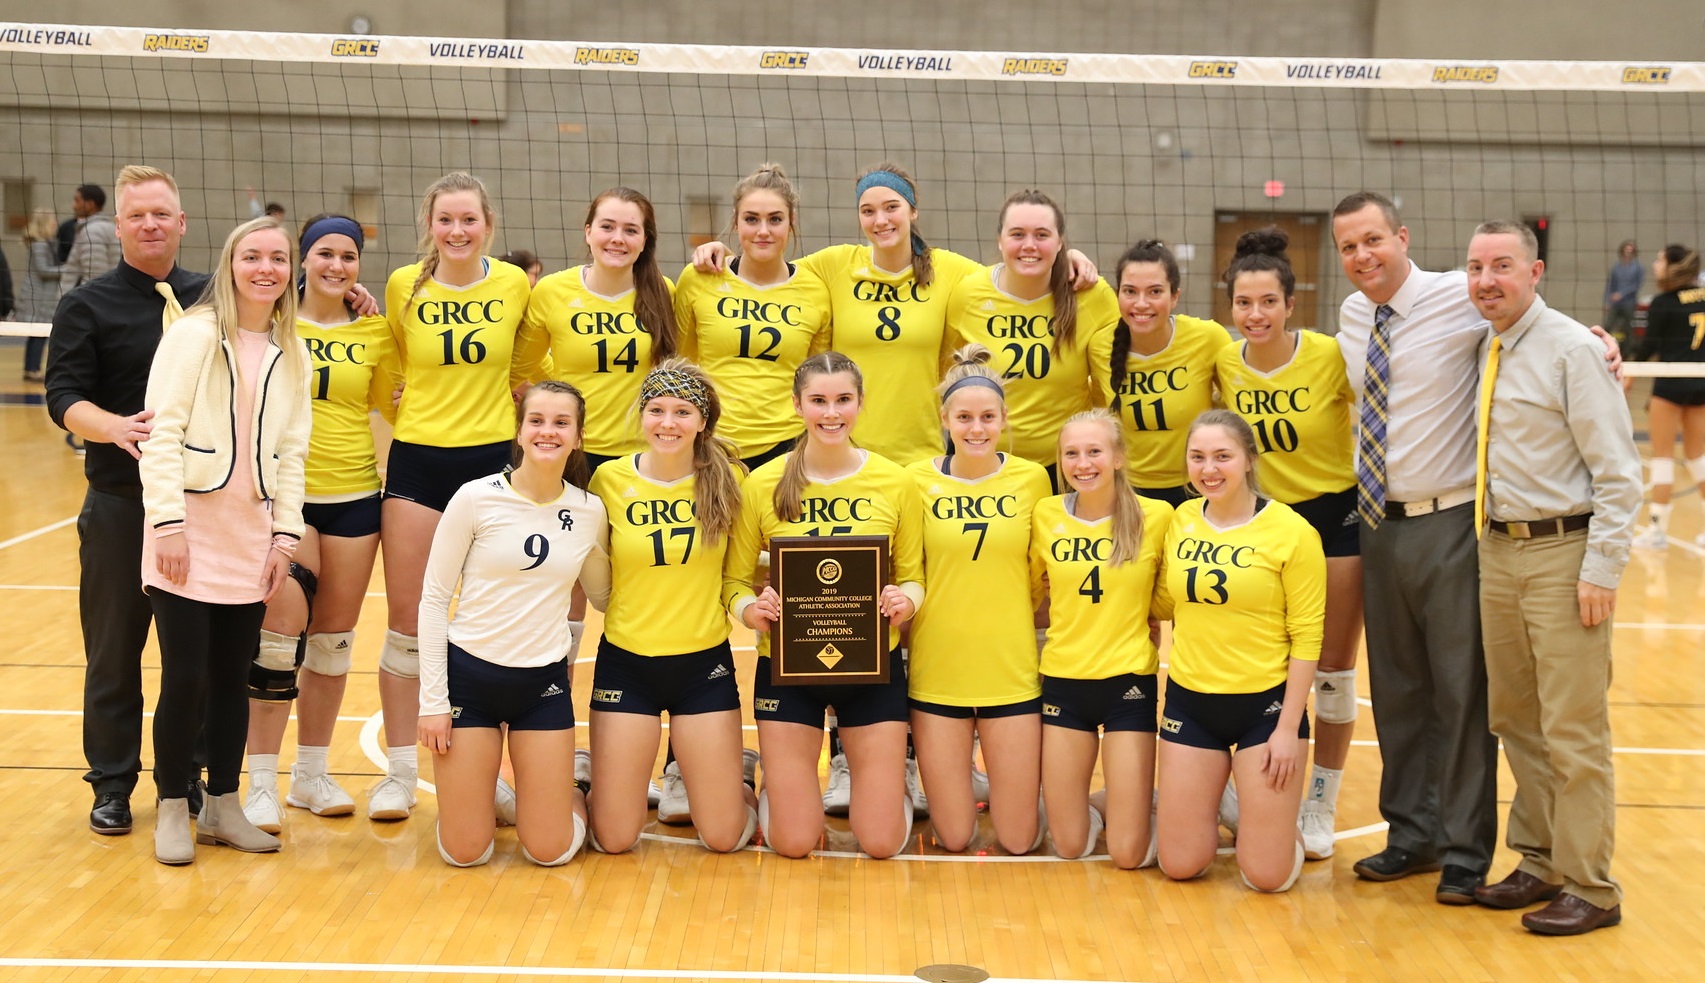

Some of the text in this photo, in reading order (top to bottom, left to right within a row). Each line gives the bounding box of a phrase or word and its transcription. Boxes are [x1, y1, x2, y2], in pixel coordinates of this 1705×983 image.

[143, 33, 209, 53] RAIDERS
[331, 38, 380, 57] GRCC
[430, 42, 524, 60] VOLLEYBALL
[574, 47, 640, 66] RAIDERS
[760, 51, 809, 70] GRCC
[858, 54, 952, 72] VOLLEYBALL
[1003, 57, 1069, 76] RAIDERS
[1188, 60, 1238, 79] GRCC
[1286, 63, 1383, 81] VOLLEYBALL
[1432, 66, 1498, 84] RAIDERS
[1621, 67, 1671, 86] GRCC
[853, 279, 931, 303] GRCC
[417, 299, 504, 325] GRCC
[717, 296, 801, 326] GRCC
[875, 306, 902, 341] 8
[303, 337, 366, 365] RCC
[437, 327, 487, 367] 16
[591, 337, 639, 374] 14
[734, 324, 782, 362] 12
[1001, 342, 1051, 380] 20
[1126, 397, 1174, 432] 11
[1235, 386, 1311, 415] GRCC
[1251, 418, 1299, 455] 10
[625, 498, 700, 526] GRC
[932, 494, 1018, 520] GRCC
[519, 533, 550, 571] 9
[645, 526, 696, 568] 17
[962, 522, 989, 561] 7
[1051, 537, 1132, 562] GRC
[1176, 537, 1256, 569] GRCC
[1079, 565, 1104, 604] 4
[1183, 565, 1229, 606] 13
[806, 627, 853, 636] CHAMPIONS
